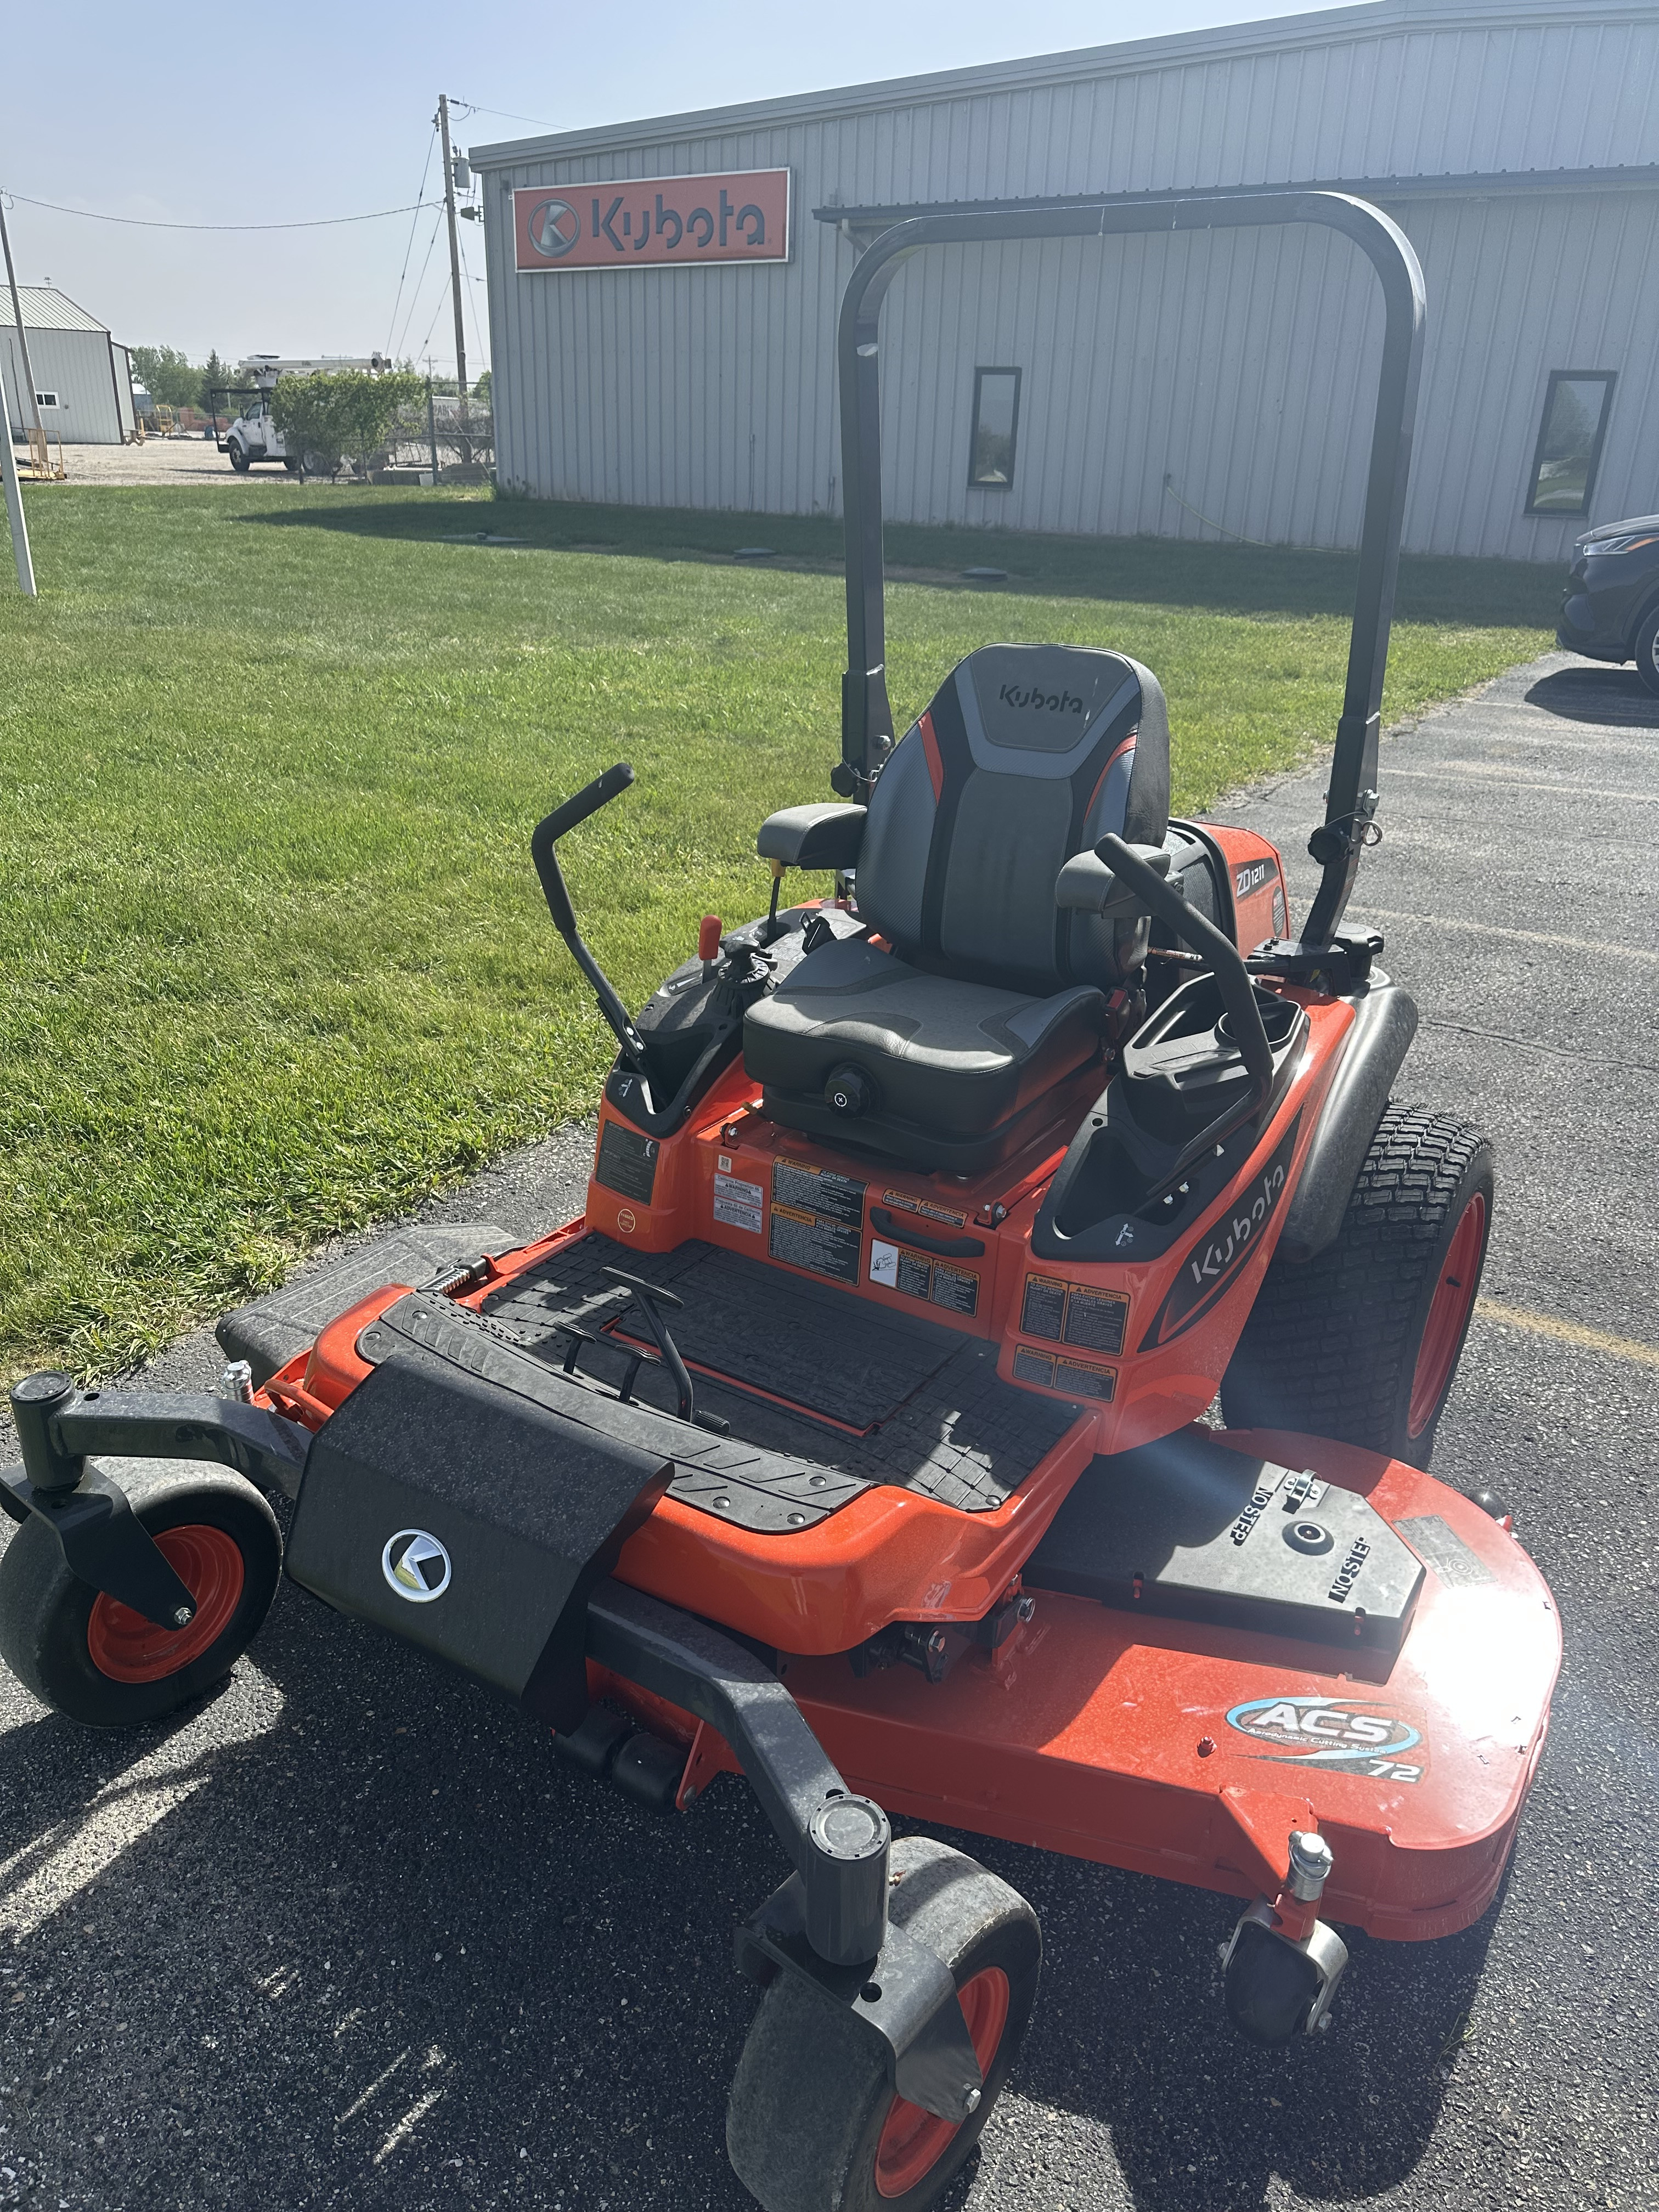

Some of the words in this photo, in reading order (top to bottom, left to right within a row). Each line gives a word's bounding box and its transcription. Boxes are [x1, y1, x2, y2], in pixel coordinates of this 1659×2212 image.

[591, 189, 765, 251] Kubota
[999, 684, 1083, 713] Kubota
[788, 1159, 811, 1170] WARNING
[729, 1183, 748, 1193] WARNING
[895, 1192, 917, 1202] WARNING
[724, 1205, 752, 1217] ADVERTENCIA
[780, 1209, 812, 1223] ADVERTENCIA
[929, 1204, 964, 1217] ADVERTENCIA
[1191, 1165, 1285, 1284] Kubota
[906, 1251, 930, 1263] WARNING
[940, 1263, 977, 1279] ADVERTENCIA
[1039, 1278, 1062, 1287] WARNING
[1084, 1288, 1122, 1300] ADVERTENCIA
[1026, 1349, 1052, 1361] WARNING
[1068, 1361, 1110, 1374] ADVERTENCIA
[1251, 1486, 1274, 1506] NO
[1232, 1504, 1261, 1543] STEP
[1329, 1573, 1353, 1600] NO
[1342, 1536, 1371, 1574] STEP
[1251, 1702, 1393, 1743] ACS
[1247, 1728, 1308, 1742] Aerodynamic
[1310, 1737, 1347, 1749] Cutting
[1351, 1743, 1387, 1754] System
[1367, 1759, 1421, 1783] 72
